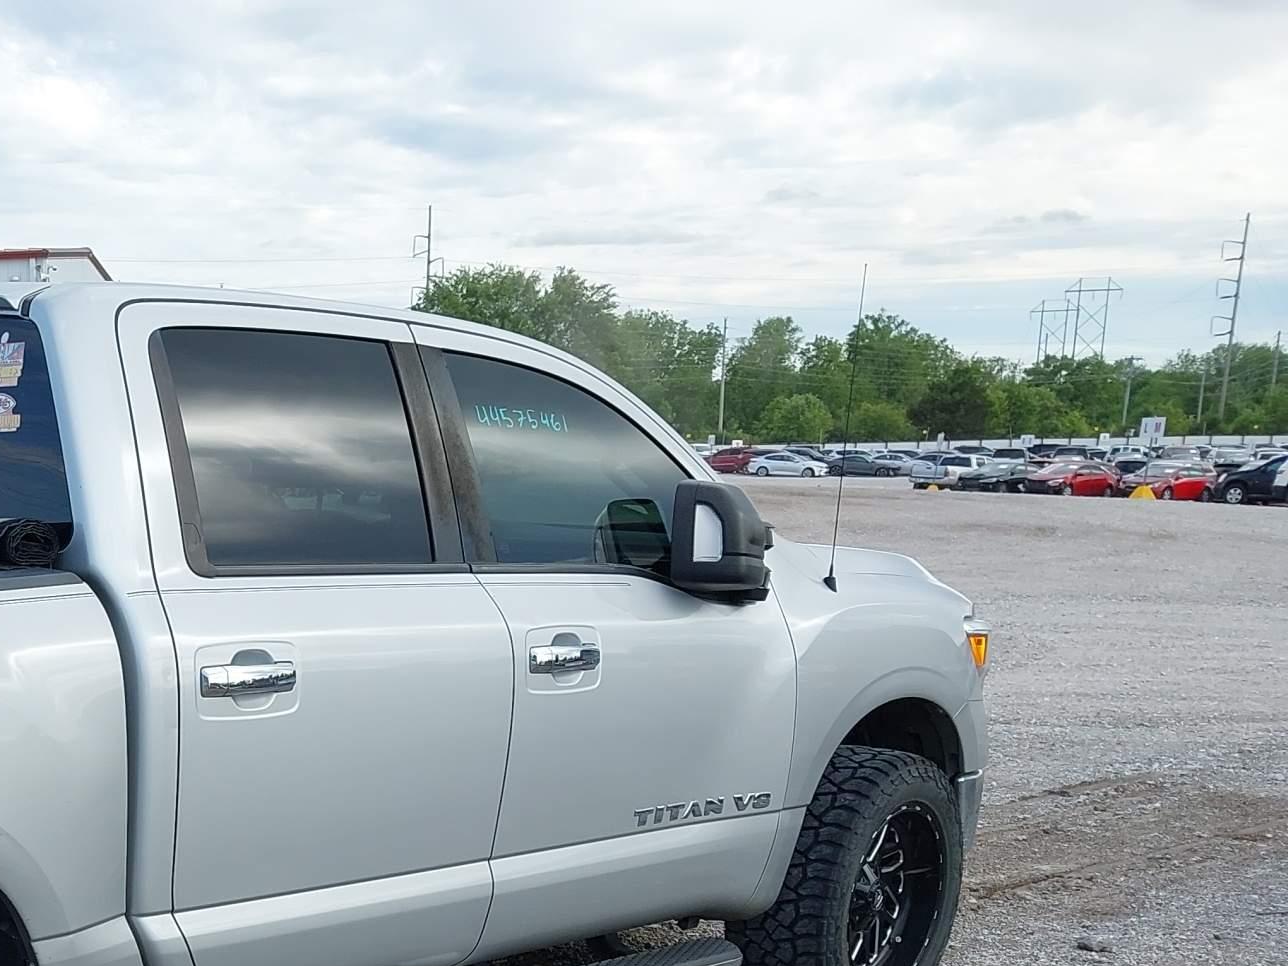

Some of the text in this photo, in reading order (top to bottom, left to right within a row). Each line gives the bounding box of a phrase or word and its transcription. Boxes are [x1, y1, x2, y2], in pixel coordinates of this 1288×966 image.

[475, 405, 568, 433] 44575461
[633, 792, 772, 827] TITAN V8
